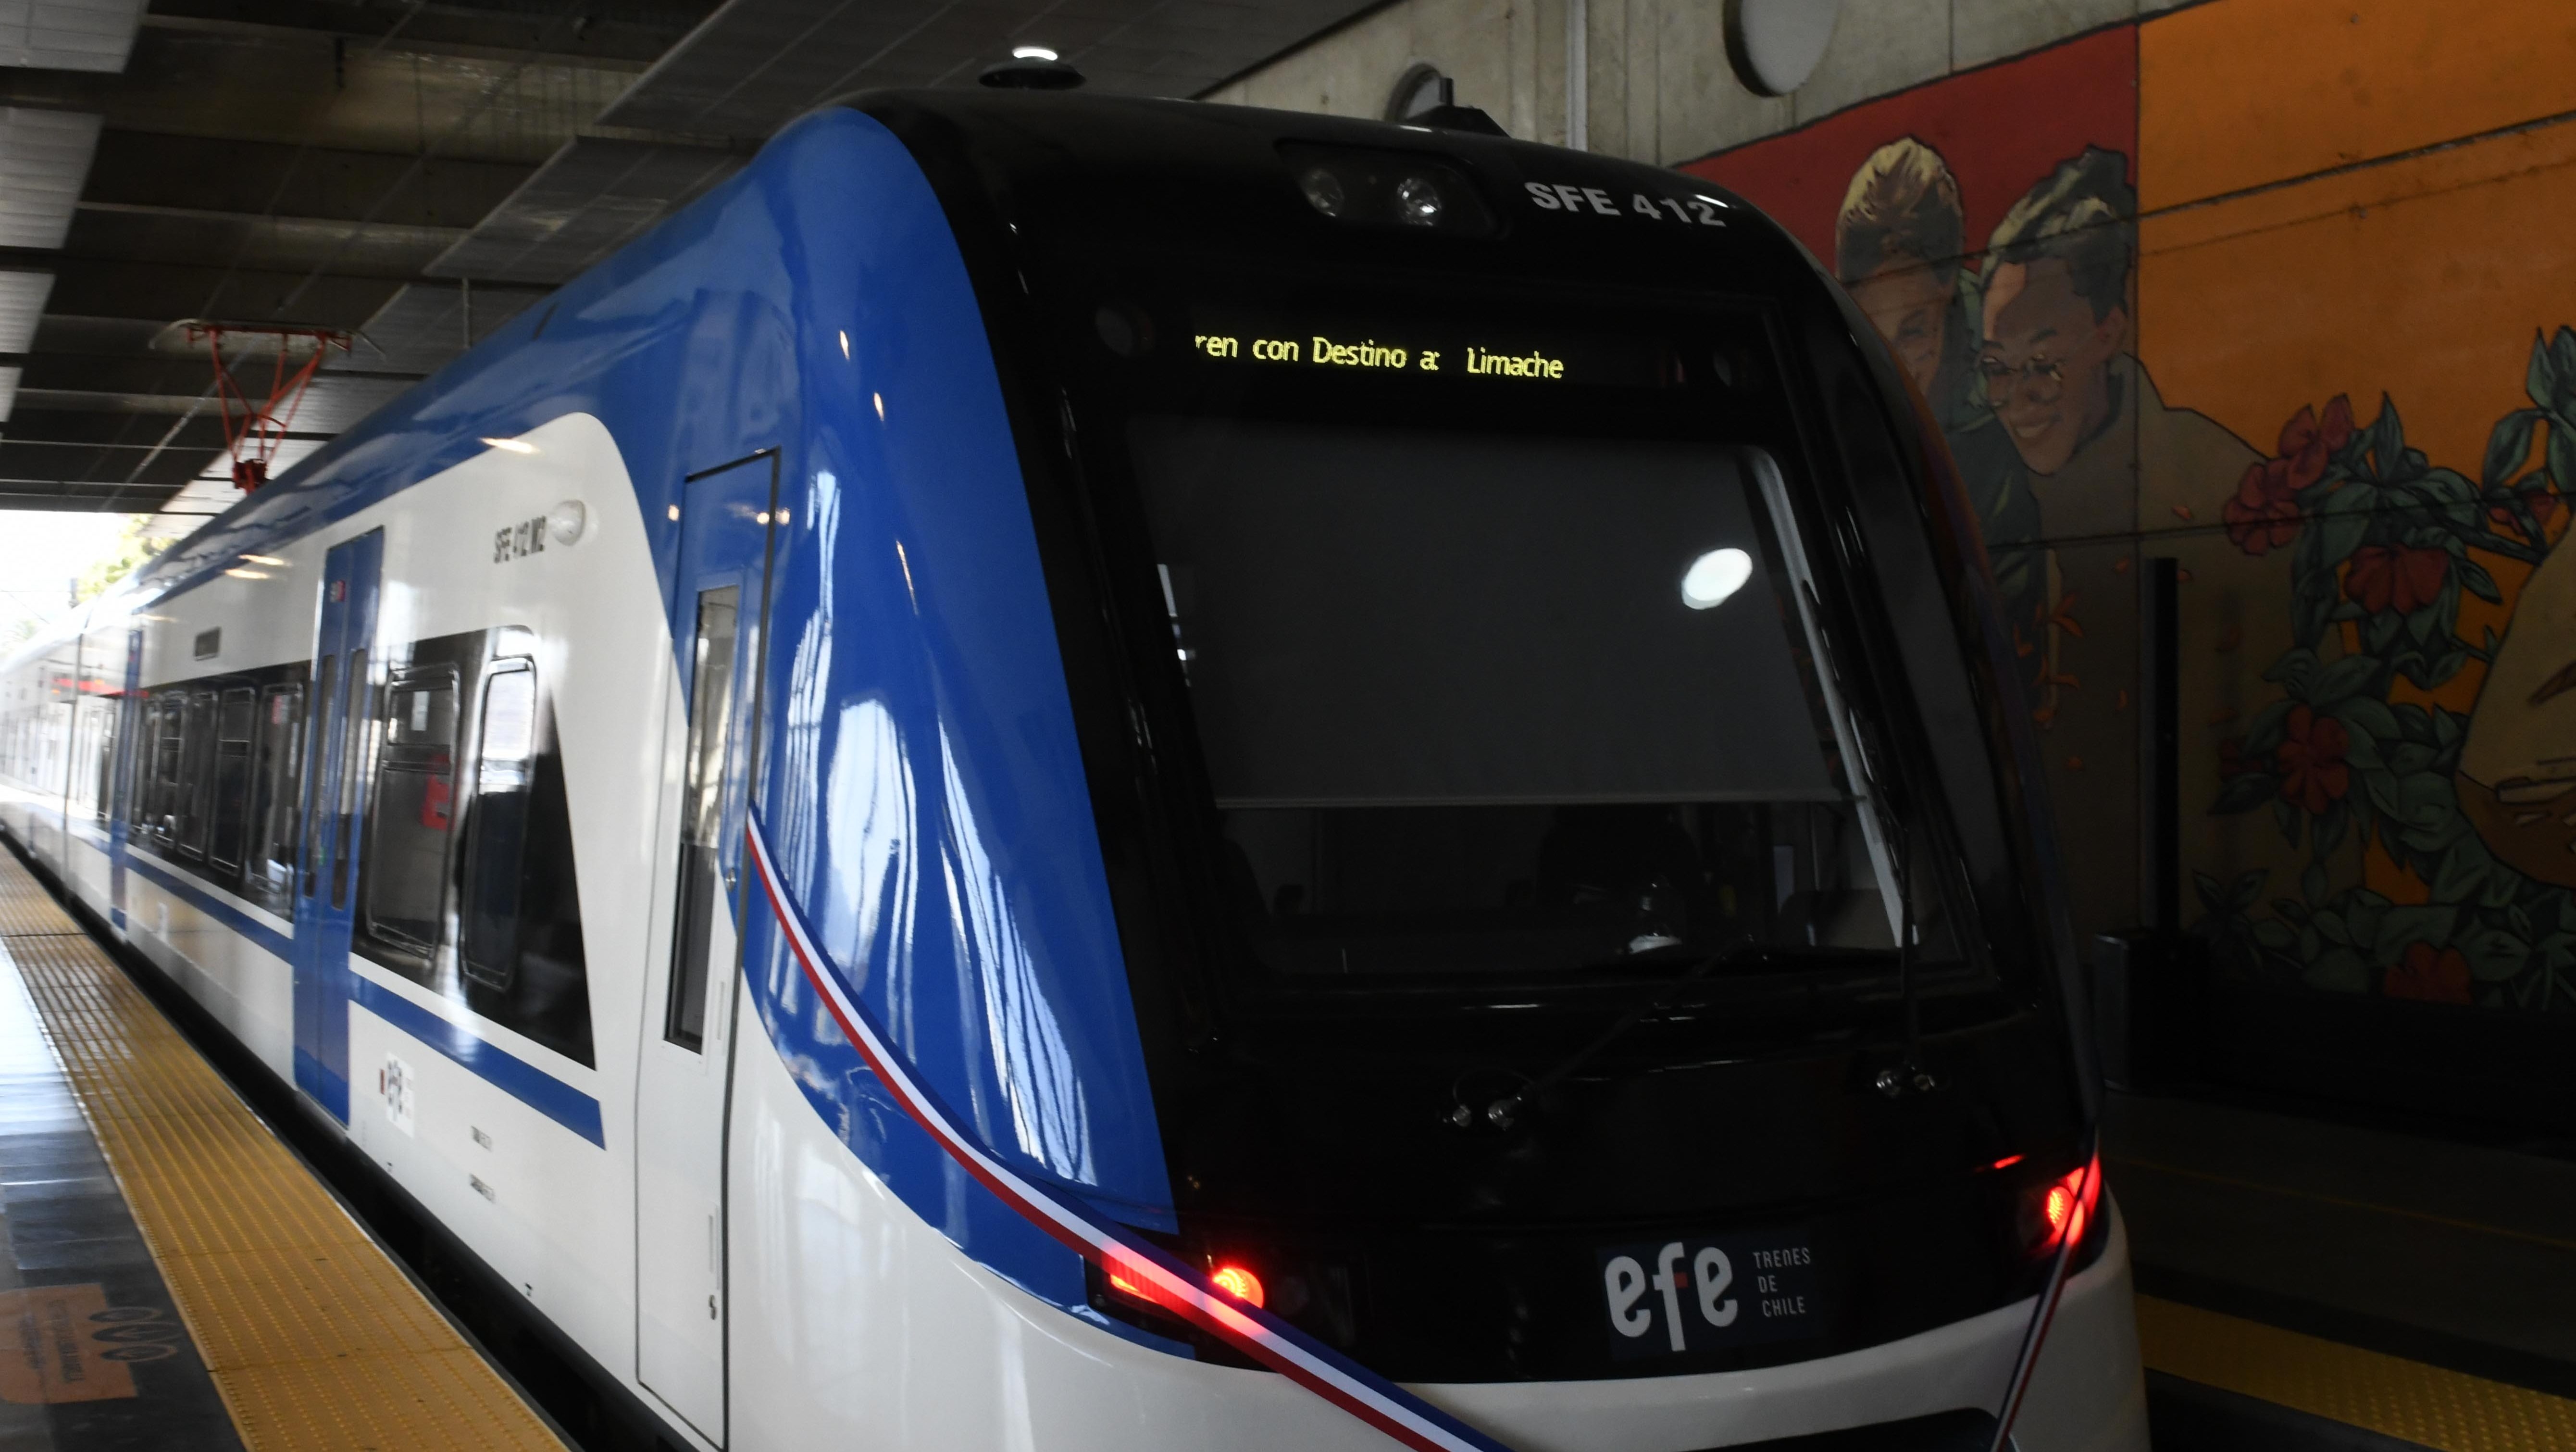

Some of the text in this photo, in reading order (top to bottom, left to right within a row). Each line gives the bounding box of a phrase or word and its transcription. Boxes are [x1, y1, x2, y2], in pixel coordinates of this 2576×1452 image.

[1524, 182, 1727, 227] SFE 412
[1252, 338, 1299, 362] con
[1312, 336, 1407, 368] Destino
[1467, 347, 1564, 379] Limache
[1753, 1247, 1811, 1269] TRENES
[1605, 1242, 1738, 1352] efe
[1757, 1275, 1778, 1293] DE
[1762, 1296, 1806, 1318] CHILE
